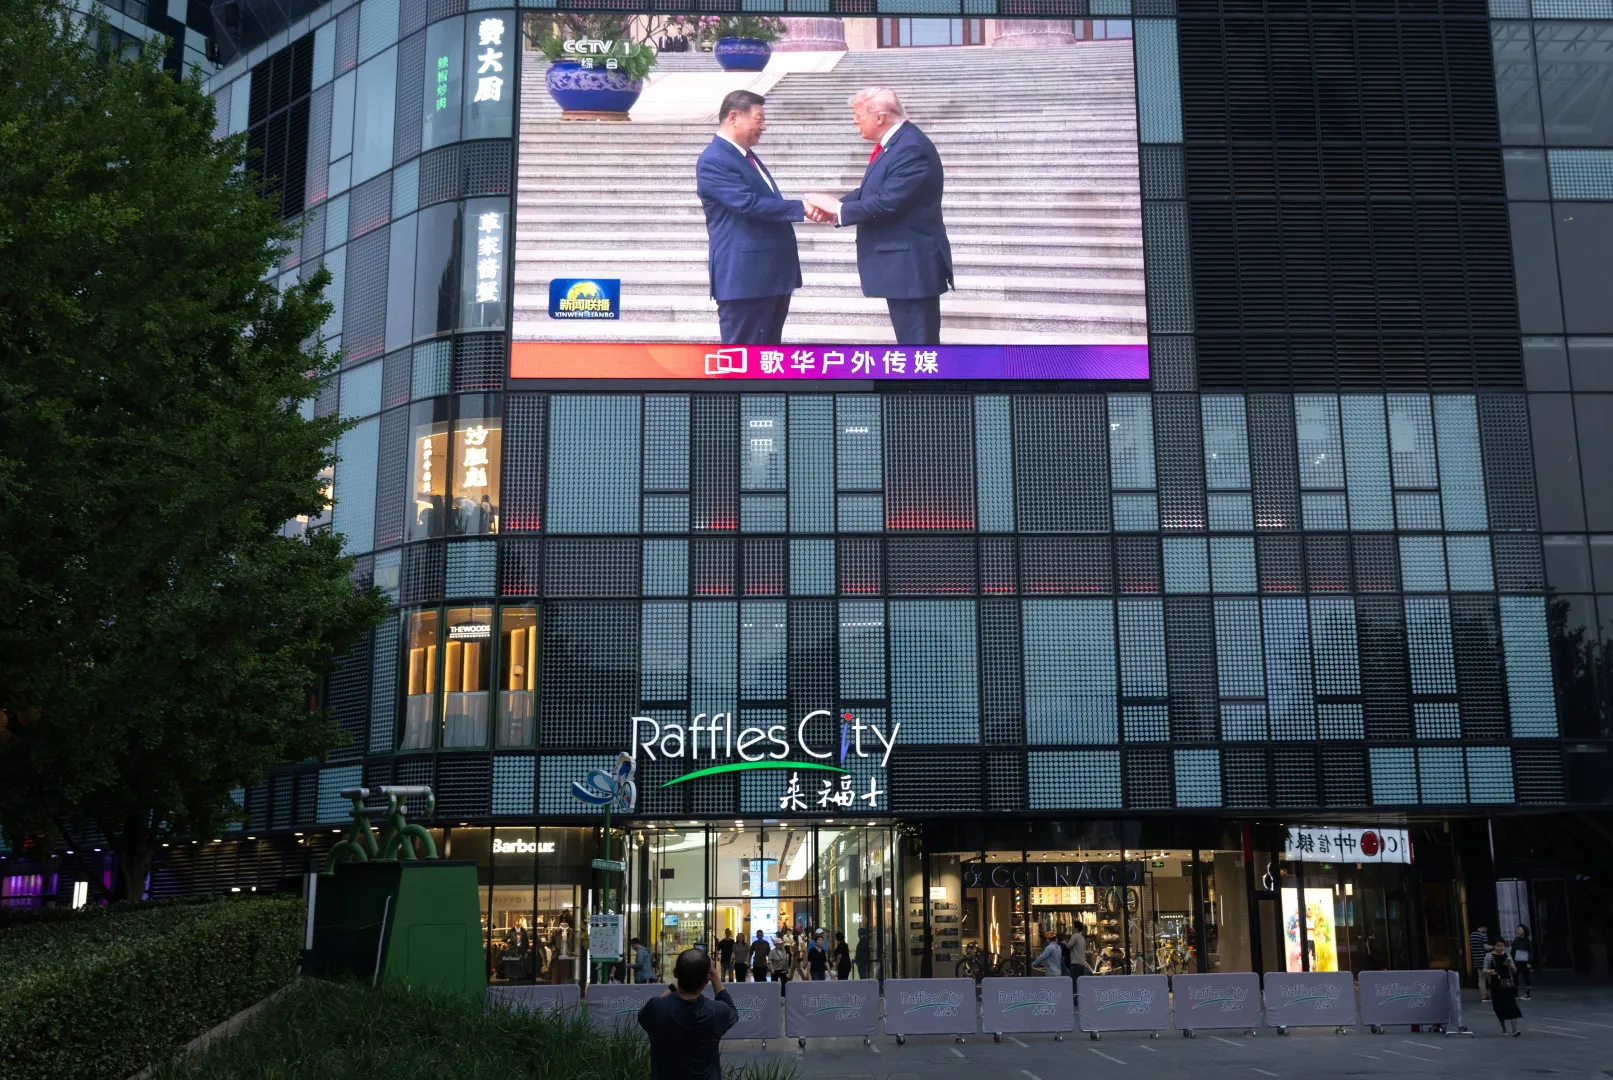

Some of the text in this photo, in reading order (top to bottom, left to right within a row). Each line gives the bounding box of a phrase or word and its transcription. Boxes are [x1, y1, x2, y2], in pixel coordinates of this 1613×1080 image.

[563, 39, 629, 55] CCTV 1
[581, 57, 618, 69] 综合
[559, 298, 610, 311] 新闻联播
[759, 350, 939, 375] 歌华户外传媒
[631, 710, 901, 767] Raffles City
[779, 772, 884, 811] 来福士
[991, 864, 1138, 887] COLNAGO
[900, 990, 964, 1006] Raffles City
[998, 989, 1061, 1005] Raffles City
[1093, 987, 1156, 1003] Raffles City
[1188, 985, 1249, 1001] Raffles City
[1280, 983, 1342, 999] Raffles City
[1374, 982, 1437, 998] Raffles City
[802, 993, 866, 1009] Raffles City
